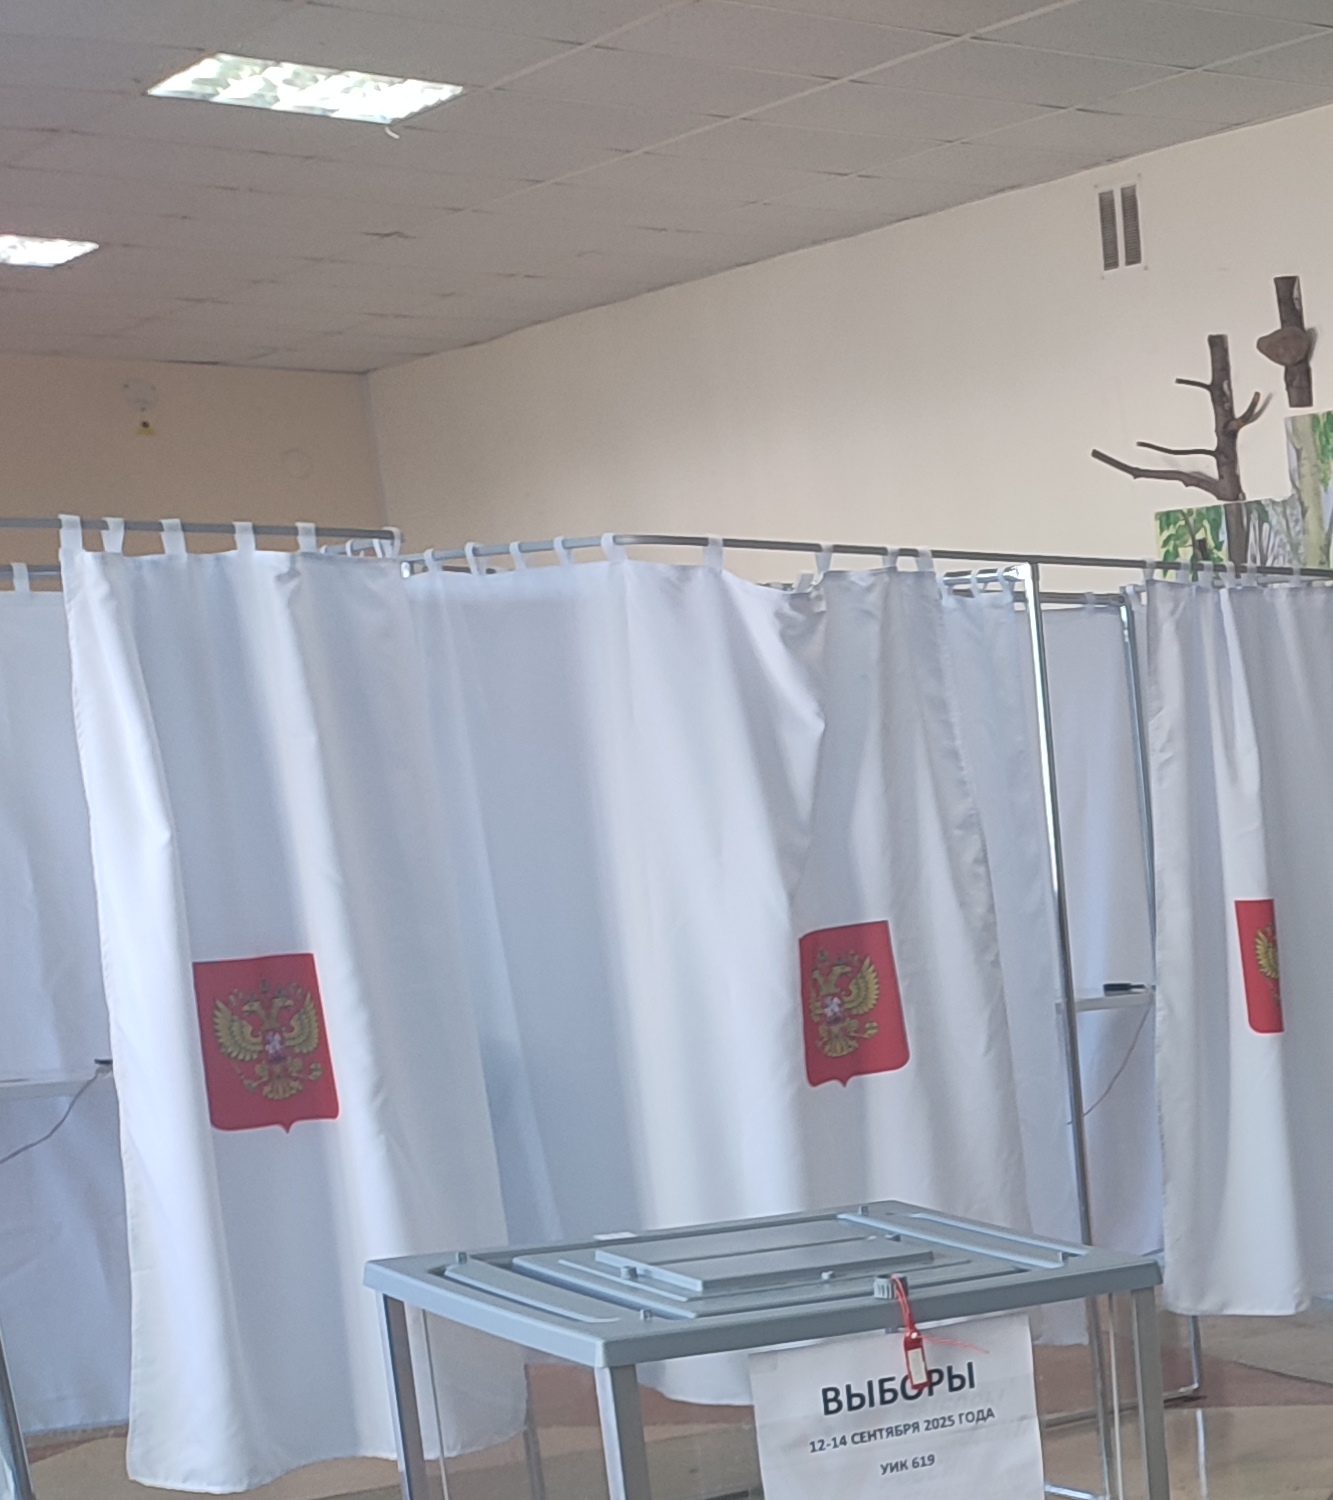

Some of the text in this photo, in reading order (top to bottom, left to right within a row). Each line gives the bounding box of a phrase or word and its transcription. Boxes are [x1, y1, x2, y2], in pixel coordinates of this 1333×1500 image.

[821, 1362, 976, 1416] ВЫБОРЫ
[809, 1407, 996, 1453] 12-14 СЕНТЯБРЯ 2025 ГОДА
[880, 1454, 936, 1476] УИК 619
